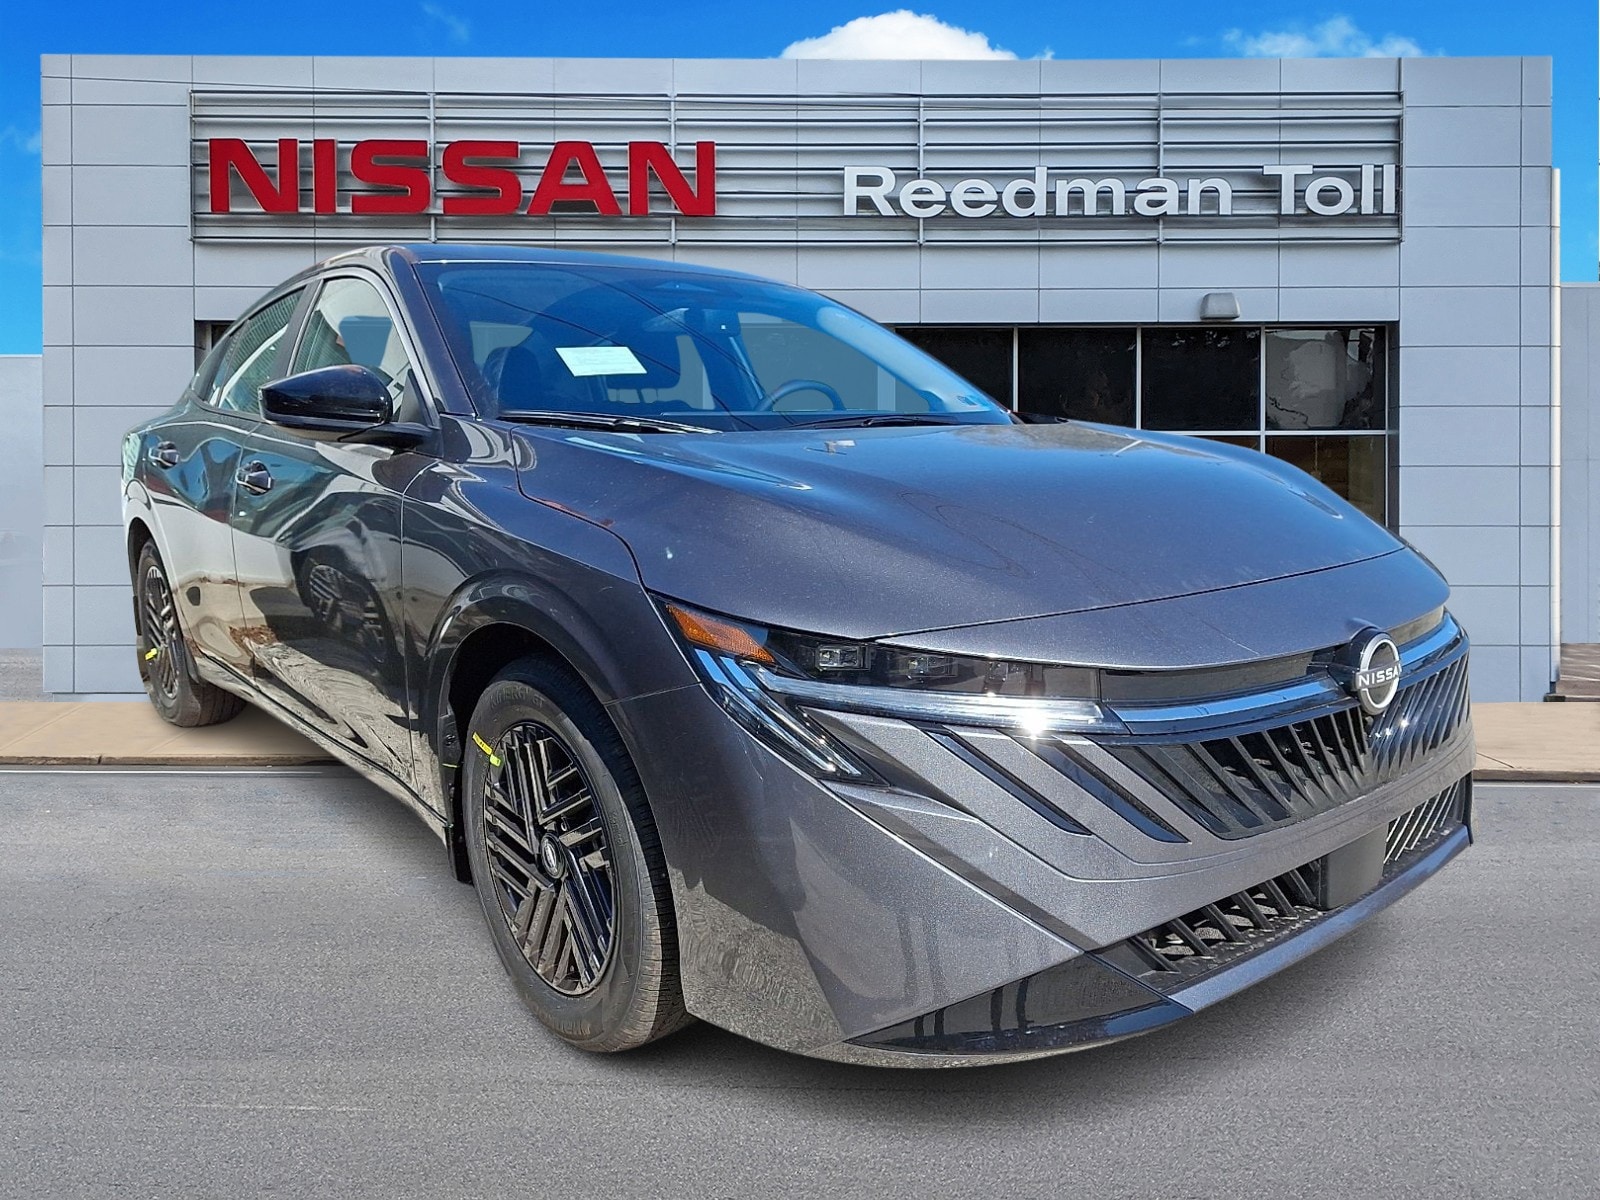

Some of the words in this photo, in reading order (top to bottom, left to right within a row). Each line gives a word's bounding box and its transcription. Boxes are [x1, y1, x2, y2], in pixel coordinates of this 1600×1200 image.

[208, 138, 716, 216] NISSAN
[843, 165, 1233, 219] Reedman
[1263, 163, 1396, 216] Toll
[1358, 663, 1402, 687] NISSA
